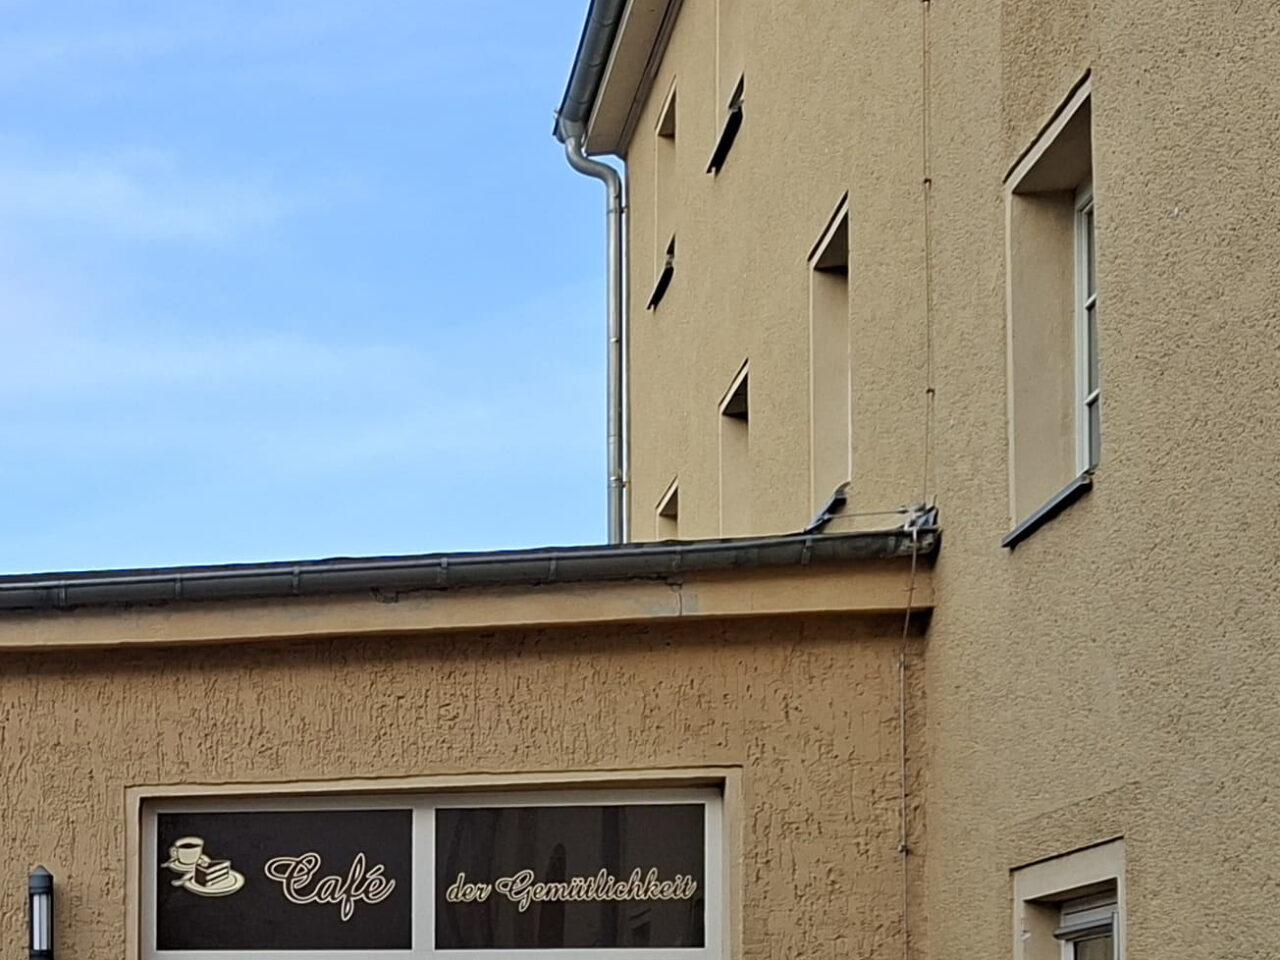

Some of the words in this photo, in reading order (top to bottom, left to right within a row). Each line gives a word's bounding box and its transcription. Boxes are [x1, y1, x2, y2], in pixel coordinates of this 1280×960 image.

[265, 852, 396, 921] Café
[447, 871, 492, 902] der
[495, 867, 698, 912] Gemütlichkeit
